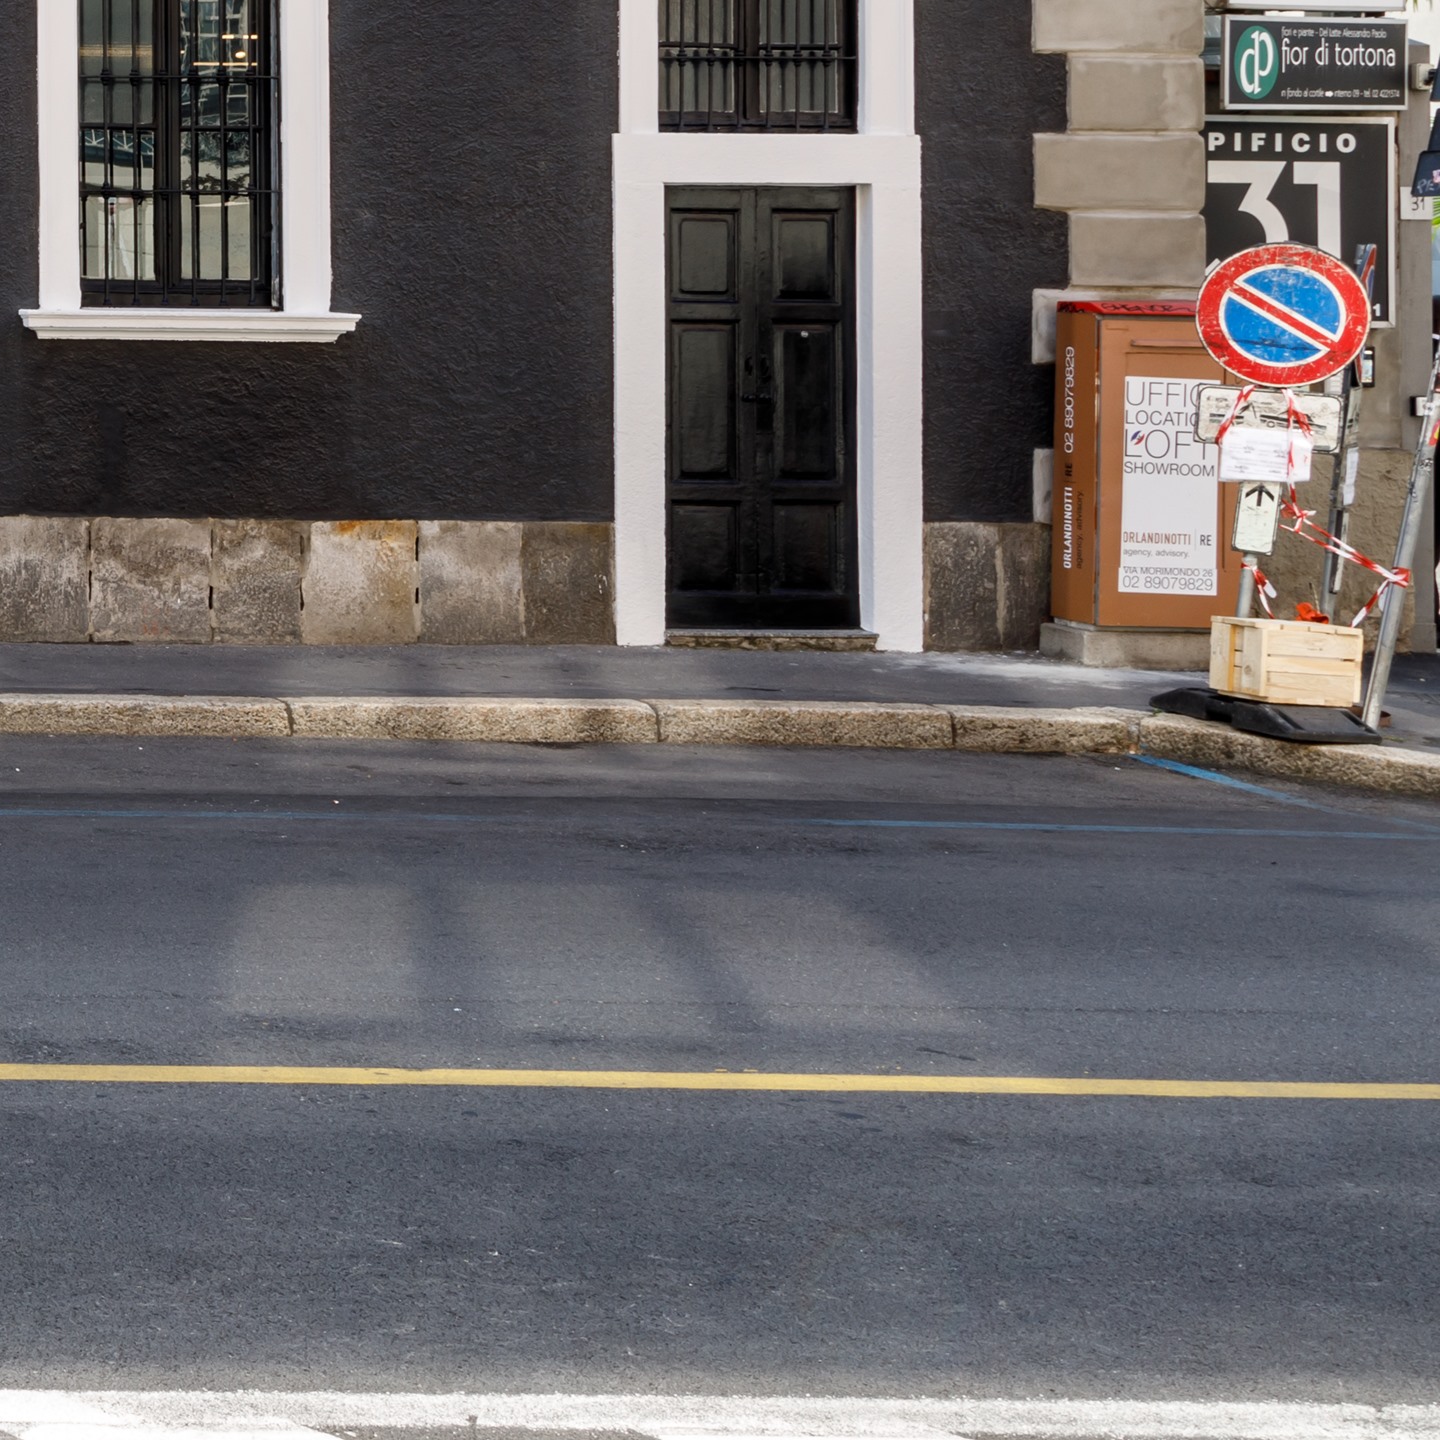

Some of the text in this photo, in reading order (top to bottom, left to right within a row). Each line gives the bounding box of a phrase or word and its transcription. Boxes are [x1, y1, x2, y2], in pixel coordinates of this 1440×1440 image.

[1281, 38, 1396, 73] fior di tortona
[1064, 346, 1075, 453] 02 89079829
[1123, 461, 1215, 477] SHOWROOM
[1063, 462, 1073, 569] ORLANDINOTTI RE
[1123, 531, 1212, 546] ORLANDINOTTI RE
[1123, 548, 1153, 558] agency,
[1140, 566, 1200, 577] MORIMONDO
[1202, 569, 1214, 578] 26
[1122, 575, 1214, 591] 02 89079829
